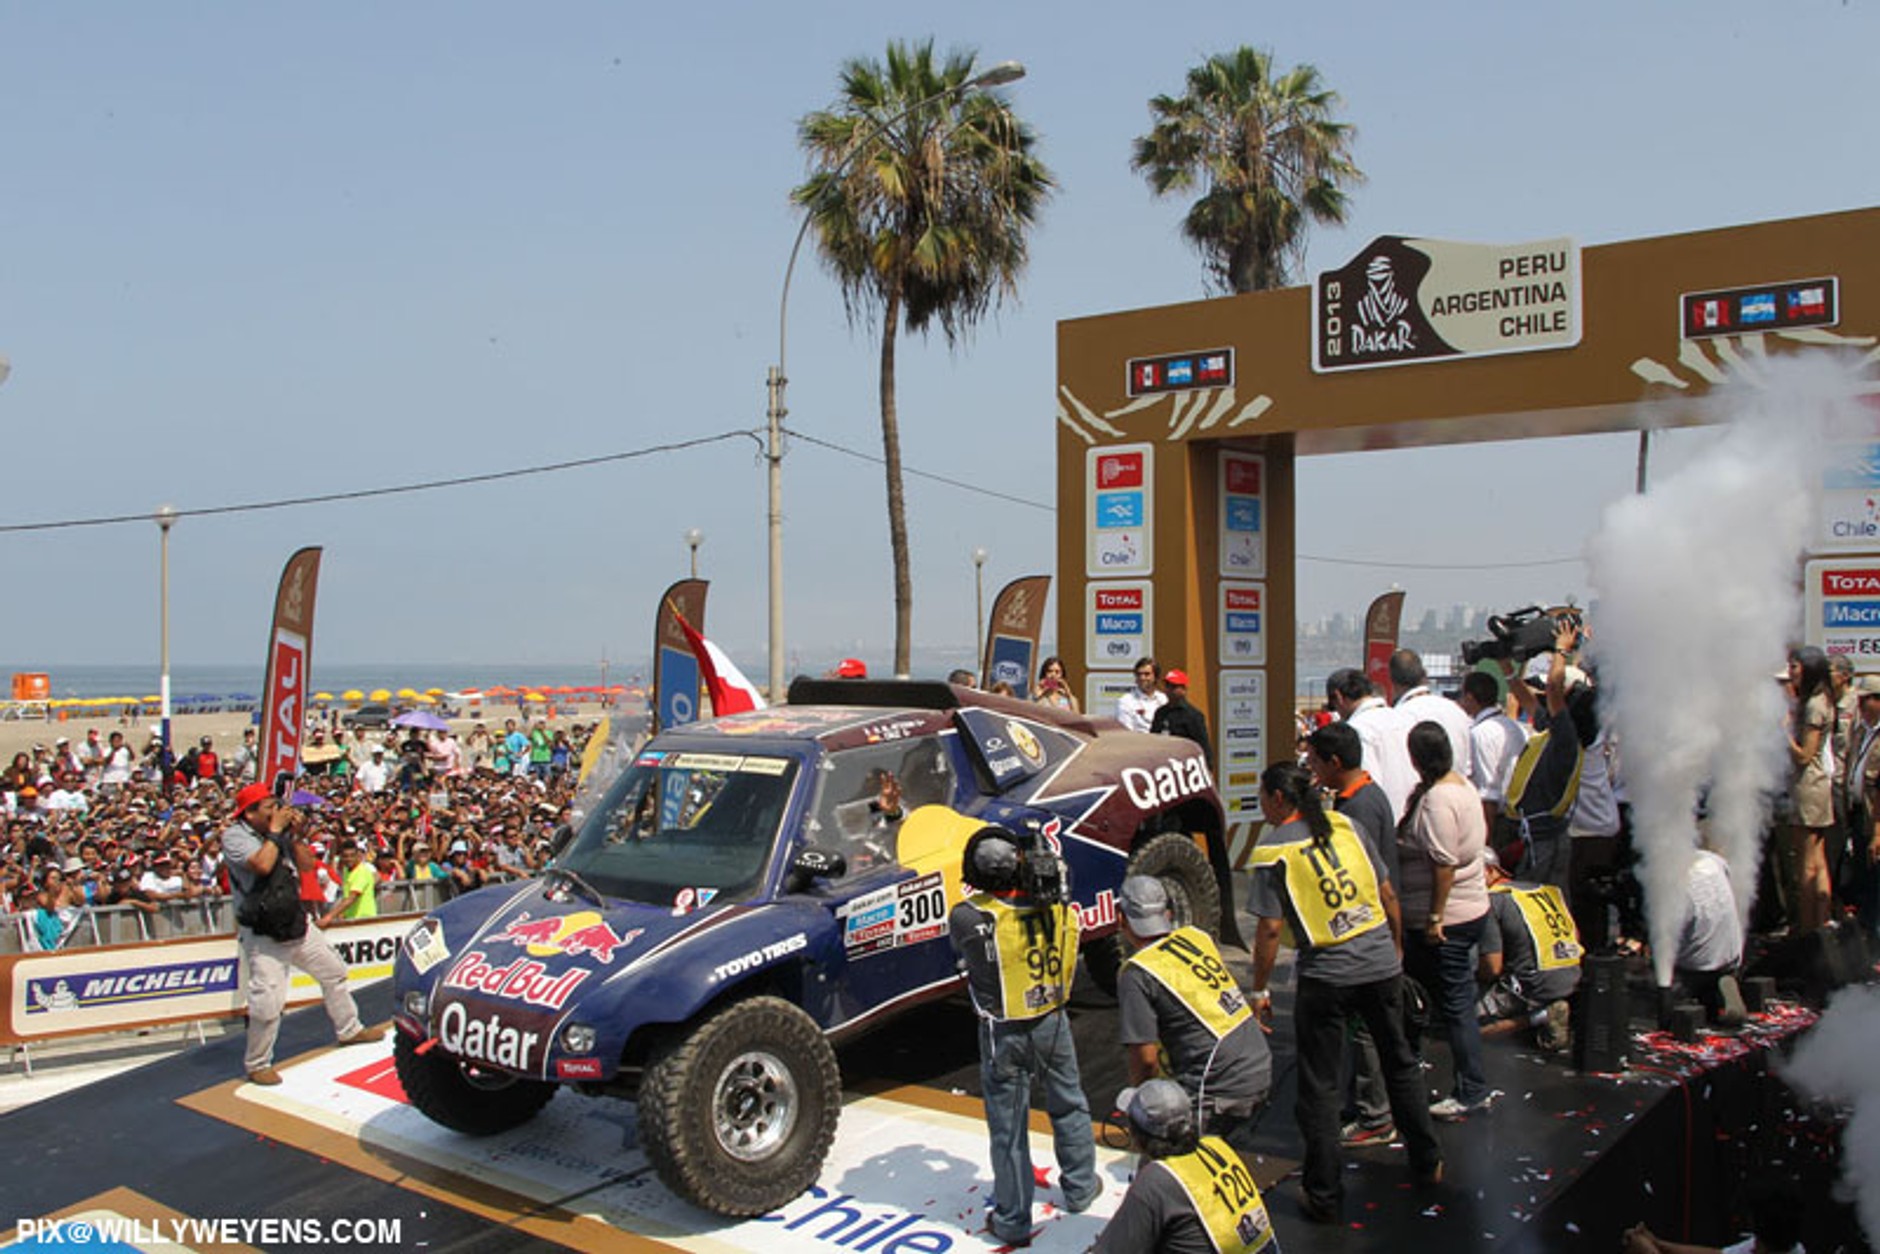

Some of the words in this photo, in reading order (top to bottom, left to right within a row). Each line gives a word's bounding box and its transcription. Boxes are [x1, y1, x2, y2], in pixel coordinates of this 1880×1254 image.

[1500, 252, 1566, 280] PERU
[1431, 282, 1567, 317] ARGENTINA
[1327, 281, 1341, 356] 2013
[1500, 311, 1567, 337] CHILE
[1351, 320, 1416, 354] DAKAR
[1833, 521, 1878, 537] Chile
[1102, 551, 1130, 565] Chile
[1828, 574, 1880, 589] TOTA
[1099, 594, 1139, 605] TOTAL
[1101, 617, 1138, 631] Macro
[1300, 835, 1341, 877] TV
[1319, 869, 1357, 909] 85
[1527, 887, 1558, 912] TV
[900, 890, 945, 928] 300
[975, 922, 993, 936] TV
[714, 950, 763, 980] TOYO
[761, 932, 808, 961] TIRES
[1027, 945, 1061, 981] 96
[1157, 934, 1204, 965] TV
[83, 964, 233, 998] MICHELIN
[443, 951, 528, 996] Red
[500, 958, 592, 1010] Bull
[1191, 956, 1229, 990] 99
[441, 1003, 538, 1070] Qatar
[562, 1062, 596, 1074] TOTAL
[1212, 1164, 1255, 1215] 120
[755, 1184, 954, 1254] hile
